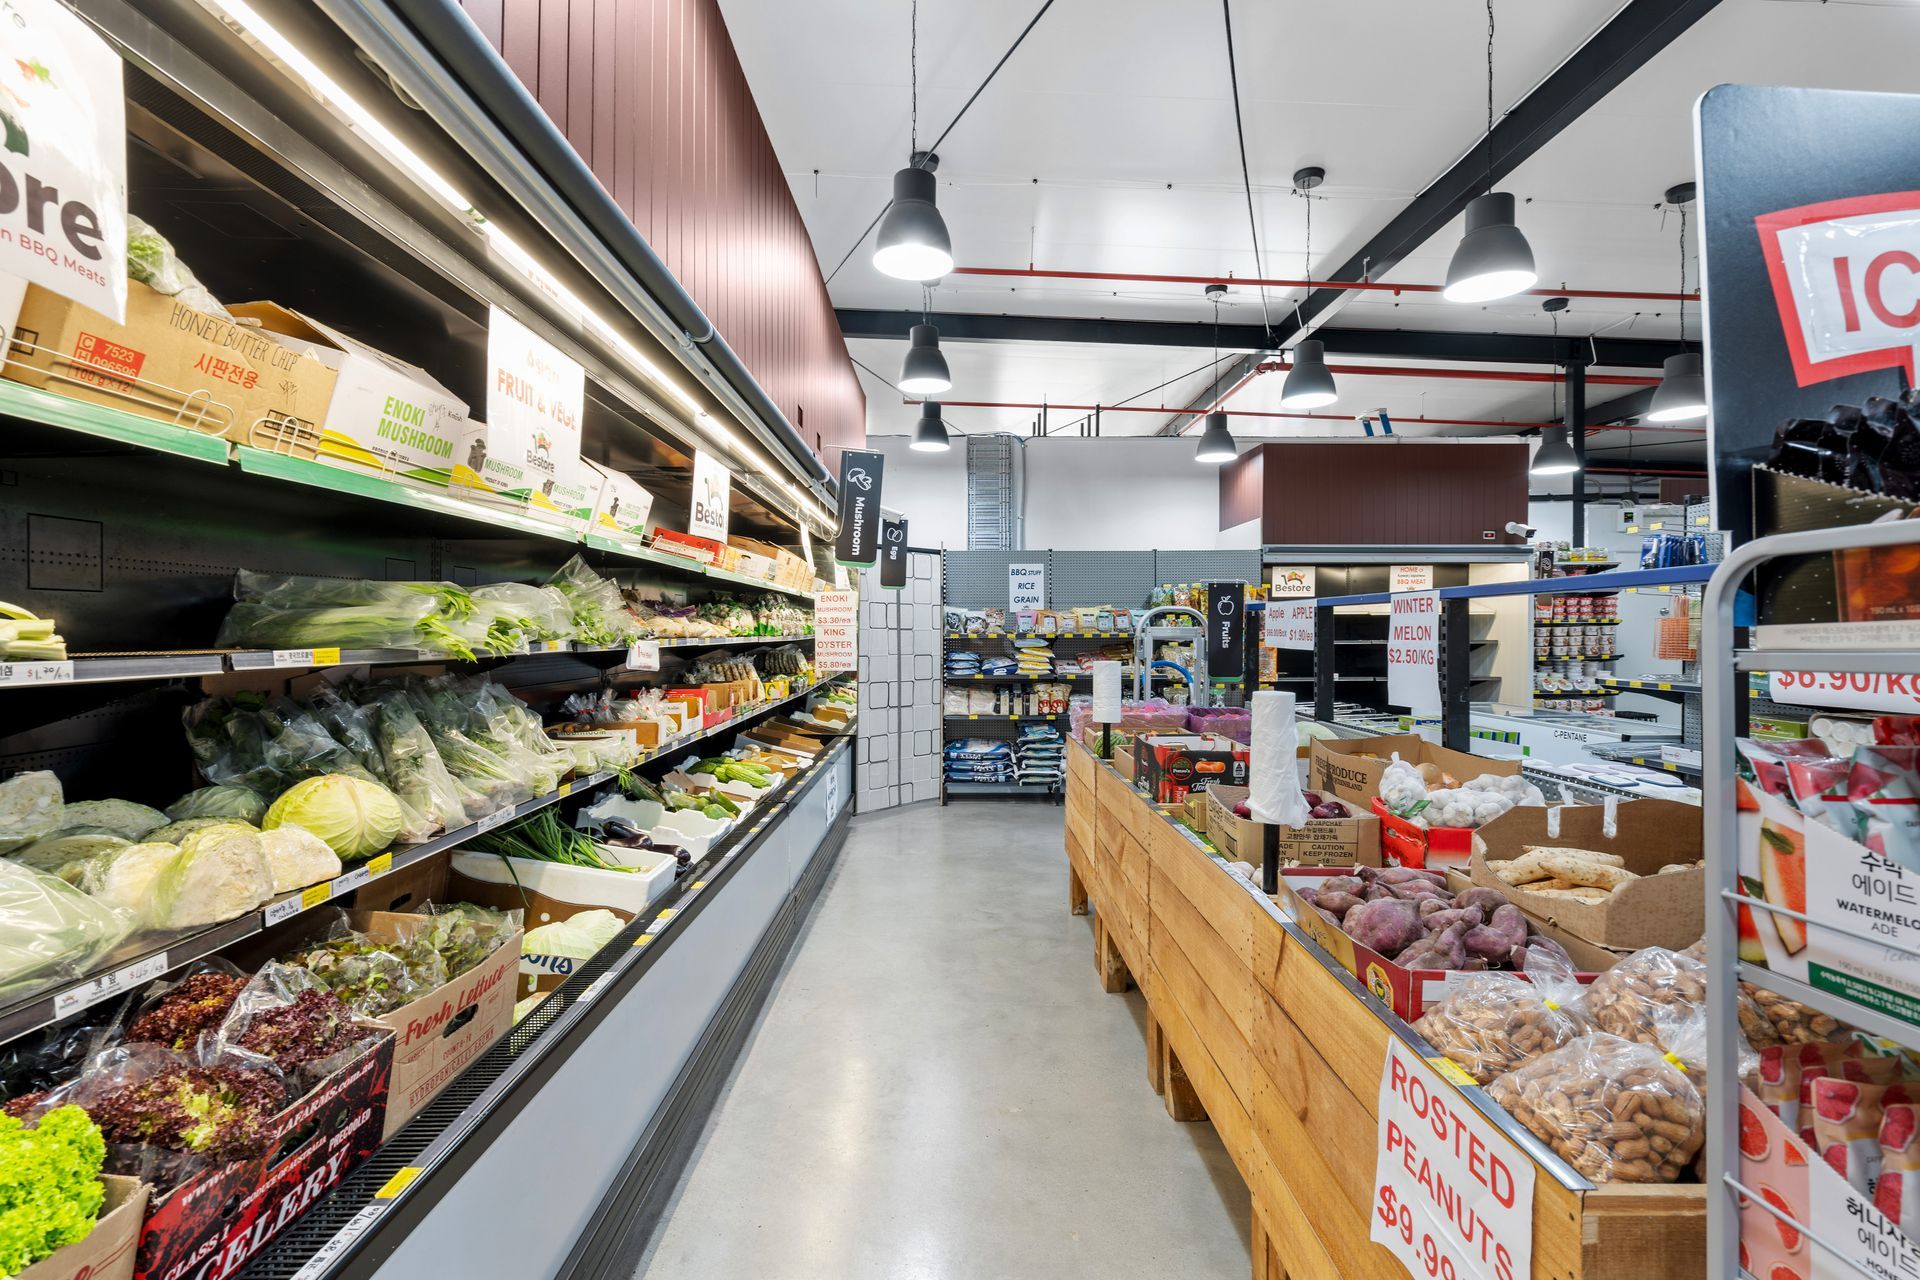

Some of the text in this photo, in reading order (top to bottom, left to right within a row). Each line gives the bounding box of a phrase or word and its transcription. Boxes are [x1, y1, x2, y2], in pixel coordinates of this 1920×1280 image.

[20, 233, 58, 266] BBQ
[64, 255, 106, 287] Meats
[170, 302, 302, 372] HONEY BUTTER CHIP
[104, 343, 135, 363] 7523
[194, 353, 260, 390] 시판전용
[497, 367, 534, 407] FRUIT
[538, 396, 546, 415] &
[383, 395, 426, 427] ENOKI
[376, 417, 454, 459] MUSHROOM
[484, 458, 524, 481] MUSHROOM
[526, 449, 556, 473] Bestore
[554, 484, 585, 501] MUSHROOM
[851, 497, 866, 556] Mushroom
[890, 546, 898, 560] Egg
[1018, 582, 1035, 590] RICE
[1275, 583, 1311, 593] Bestore
[820, 595, 848, 603] ENOKI
[1393, 597, 1434, 614] WINTER
[818, 616, 851, 625] $3.30/ea
[1268, 607, 1285, 621] Apple
[1292, 606, 1313, 619] APPLE
[823, 628, 846, 637] KING
[1222, 621, 1231, 649] Fruits
[1288, 629, 1313, 641] $1.90/ea
[1393, 625, 1432, 641] MELON
[817, 641, 852, 649] OYSTER
[818, 661, 852, 670] $5.80/ea
[1388, 648, 1434, 665] $2.50/KG
[1554, 730, 1587, 743] C-PENTANE
[1852, 873, 1918, 906] 에이드
[1871, 922, 1899, 938] ADE
[405, 963, 506, 1046] Fresh Lettuce
[329, 1107, 372, 1151] PRECOOLED
[1391, 1054, 1516, 1210] ROSTED
[1387, 1119, 1514, 1280] PEANUTS
[194, 1142, 350, 1280] CELERY
[165, 1236, 219, 1280] CLASS
[1857, 1227, 1920, 1280] 에이드
